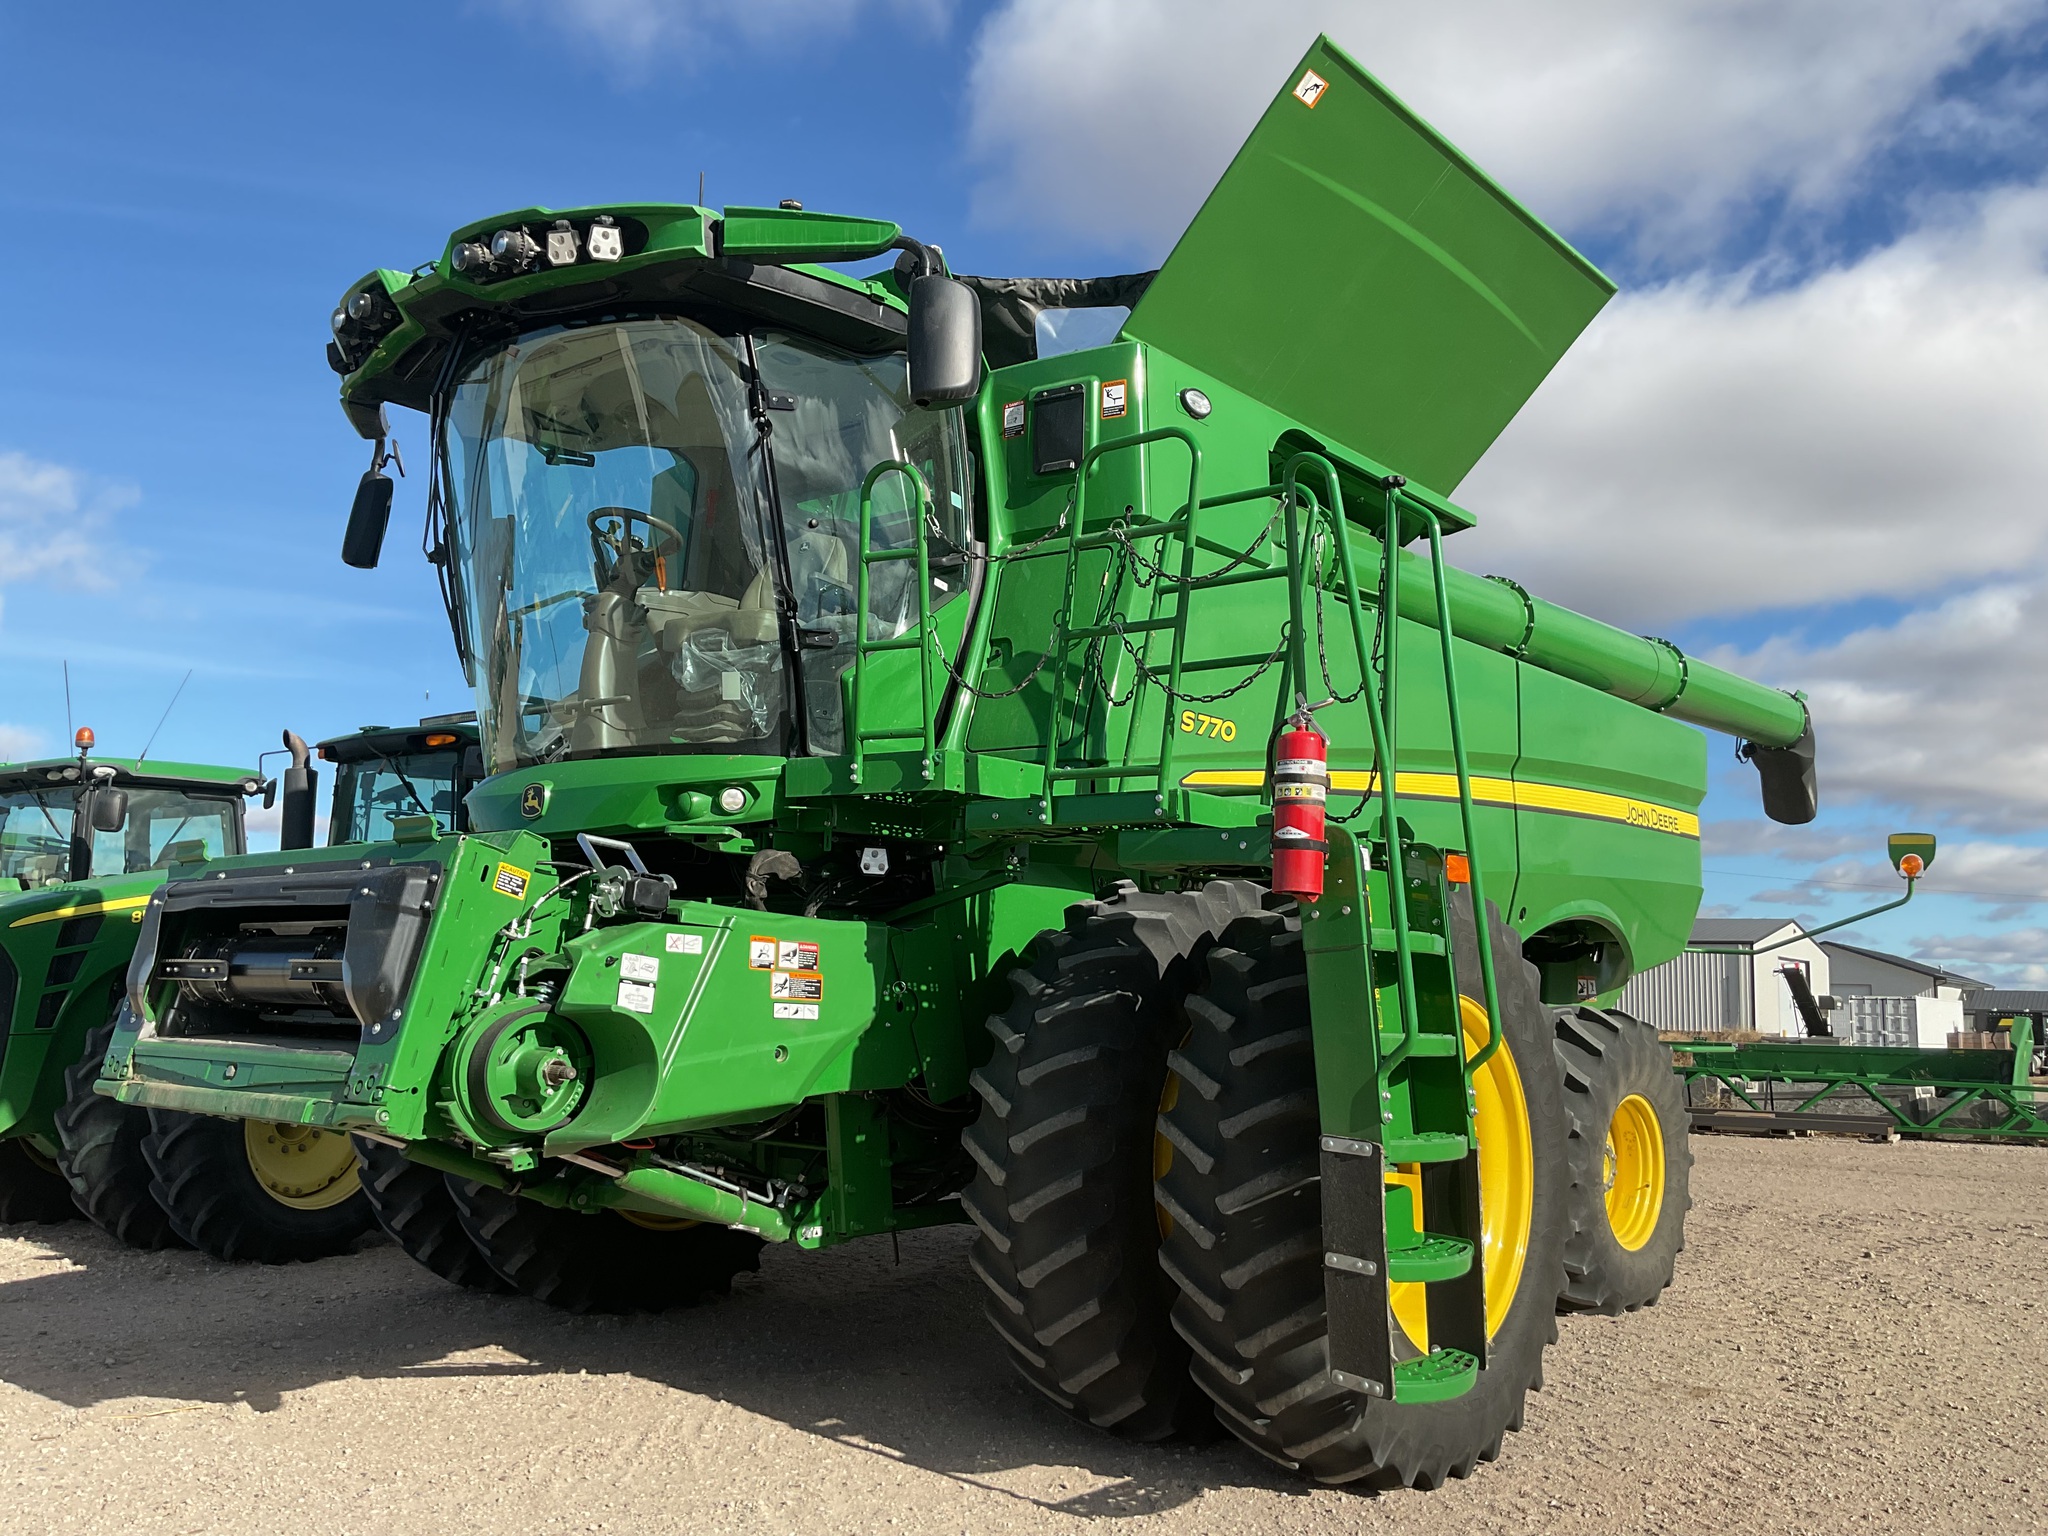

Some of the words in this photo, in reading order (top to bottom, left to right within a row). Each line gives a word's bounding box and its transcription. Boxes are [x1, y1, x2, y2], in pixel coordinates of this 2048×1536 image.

[1180, 709, 1236, 742] S770
[1626, 802, 1650, 824] JOHN
[1651, 808, 1679, 831] DEERE
[505, 865, 529, 878] CAUTION
